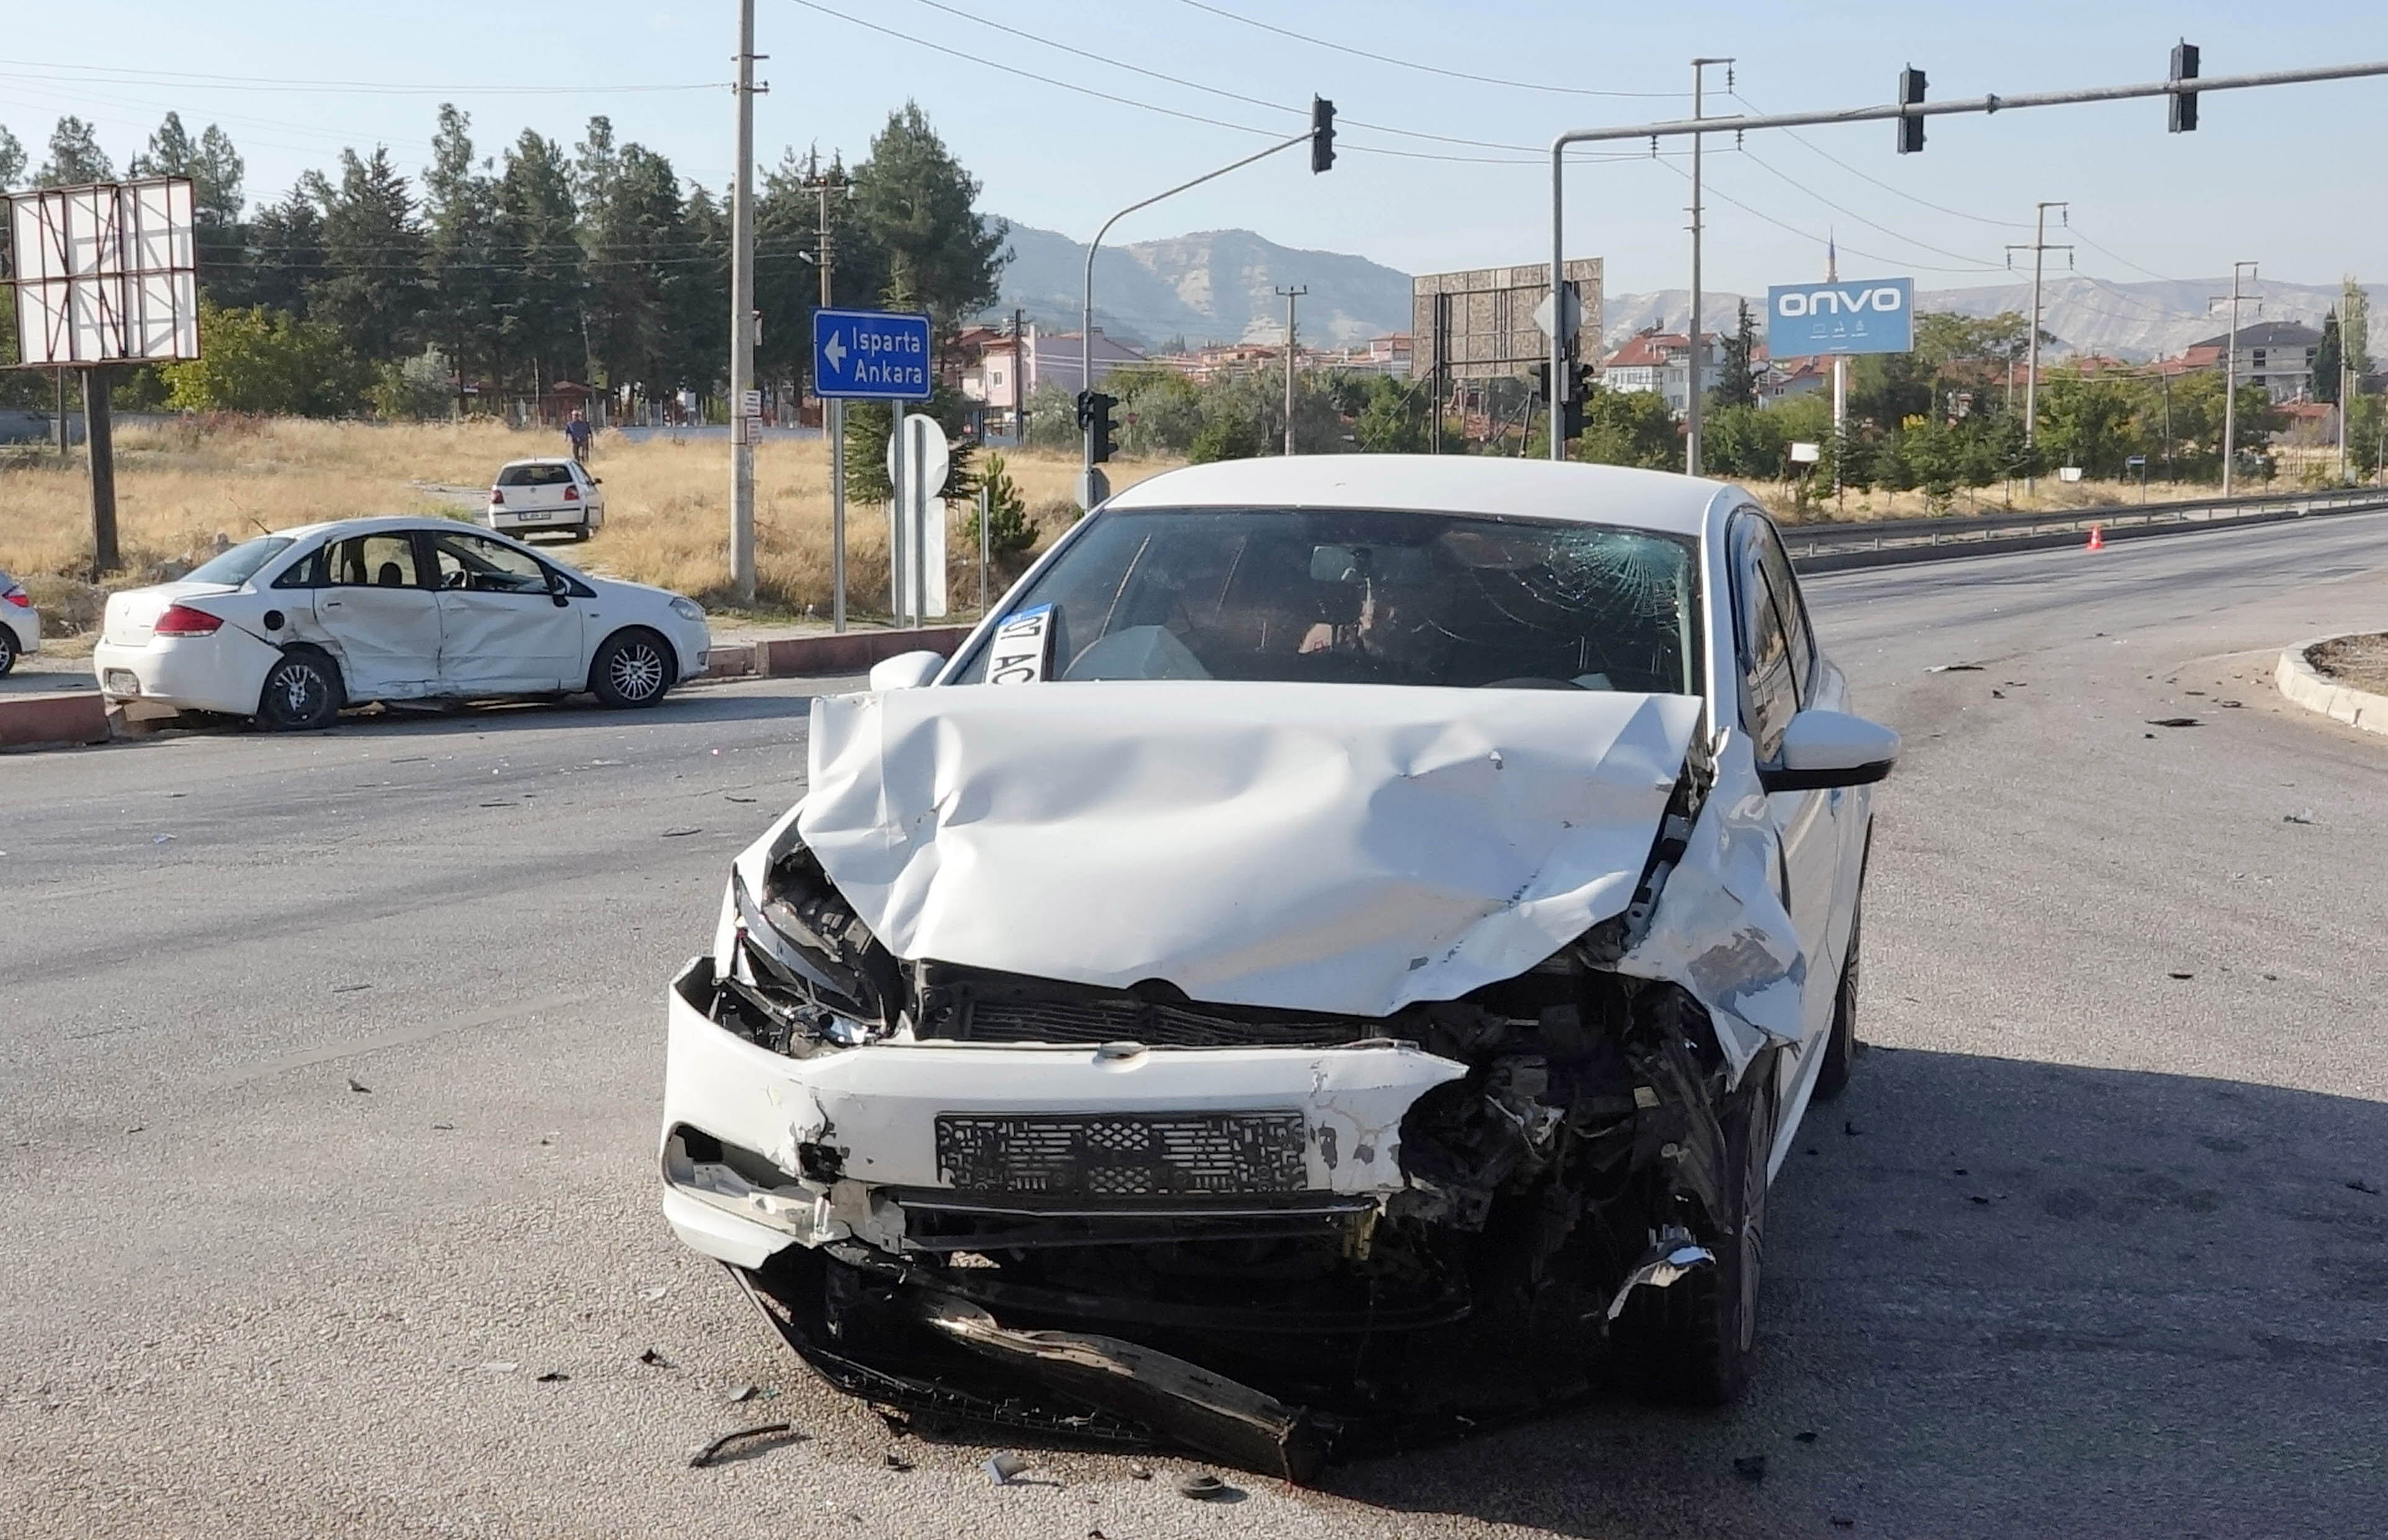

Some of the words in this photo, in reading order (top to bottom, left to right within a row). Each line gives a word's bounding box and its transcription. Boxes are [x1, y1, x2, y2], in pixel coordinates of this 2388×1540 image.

[852, 326, 921, 358] Isparta
[854, 358, 922, 384] Ankara
[1000, 616, 1044, 640] 07
[992, 654, 1038, 684] AC
